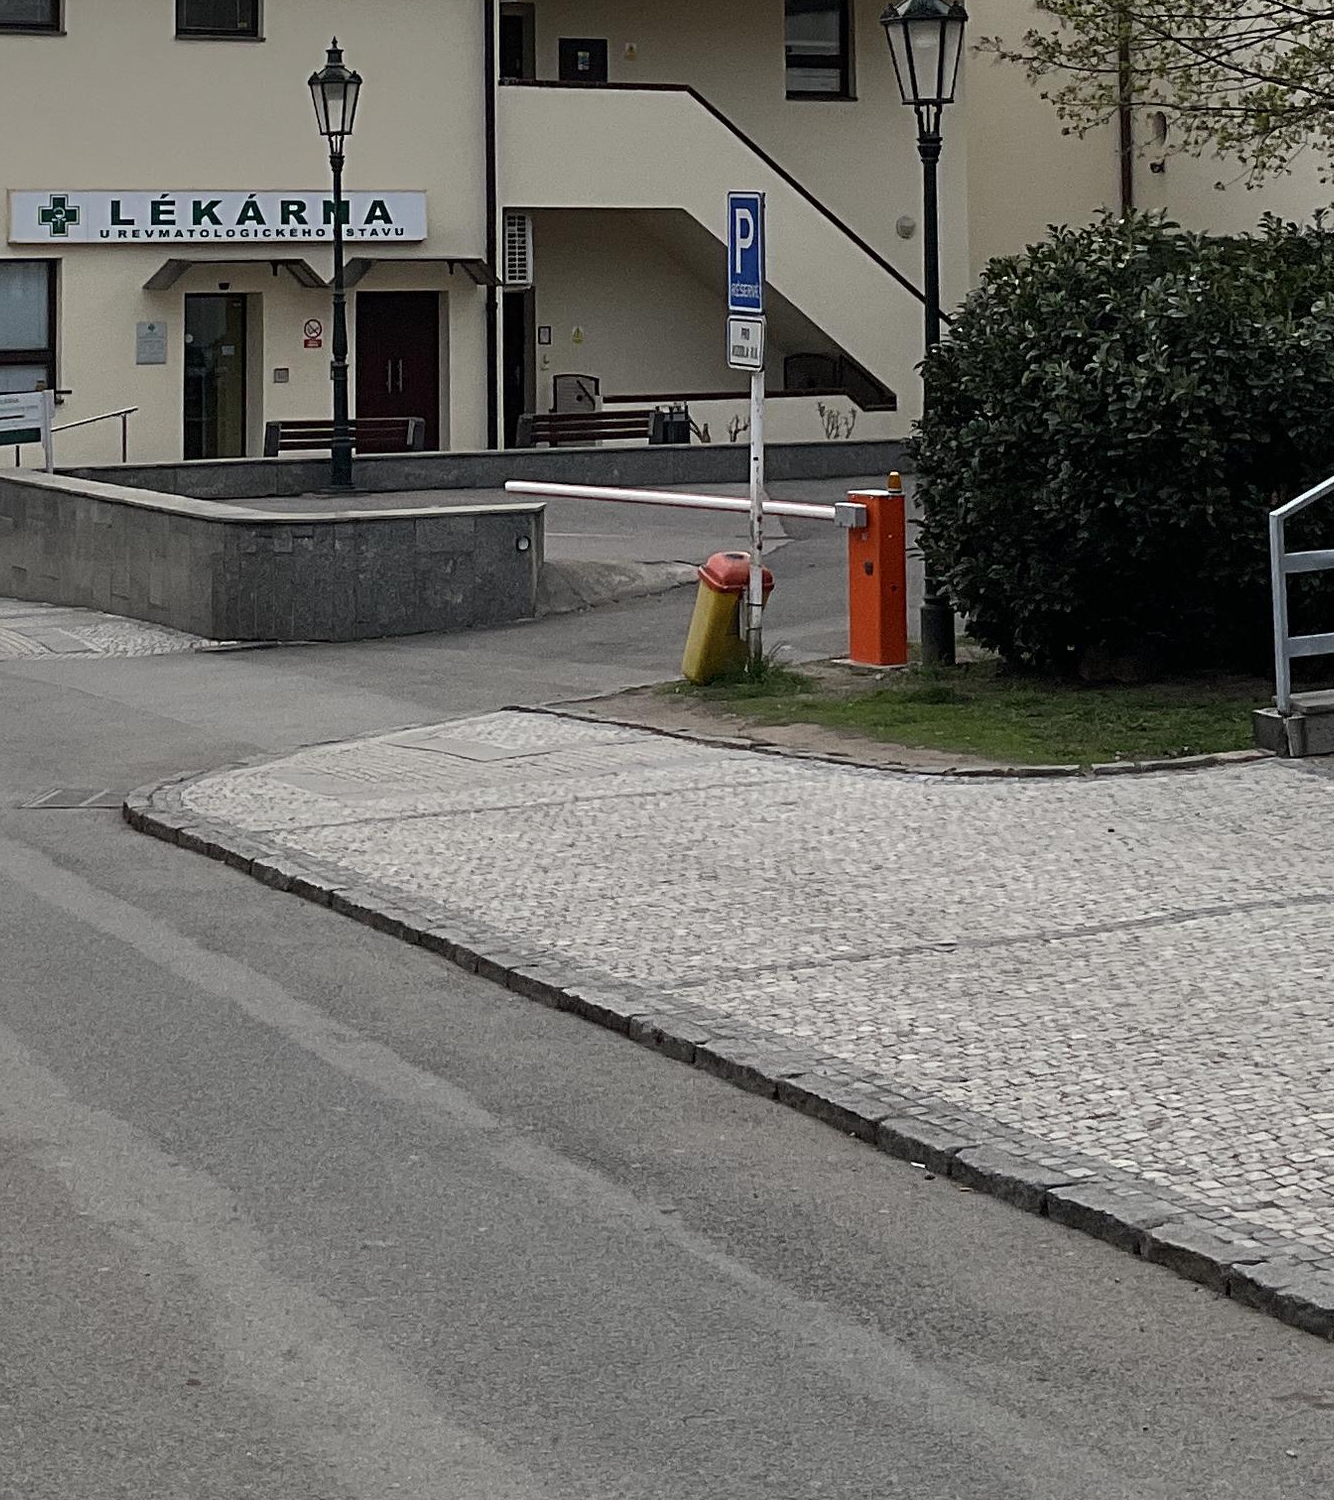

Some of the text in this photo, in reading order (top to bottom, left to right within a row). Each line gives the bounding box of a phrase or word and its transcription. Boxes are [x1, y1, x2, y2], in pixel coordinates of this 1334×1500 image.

[110, 193, 394, 226] LÉKÁRNA
[333, 227, 405, 238] STAVU
[735, 208, 754, 274] P
